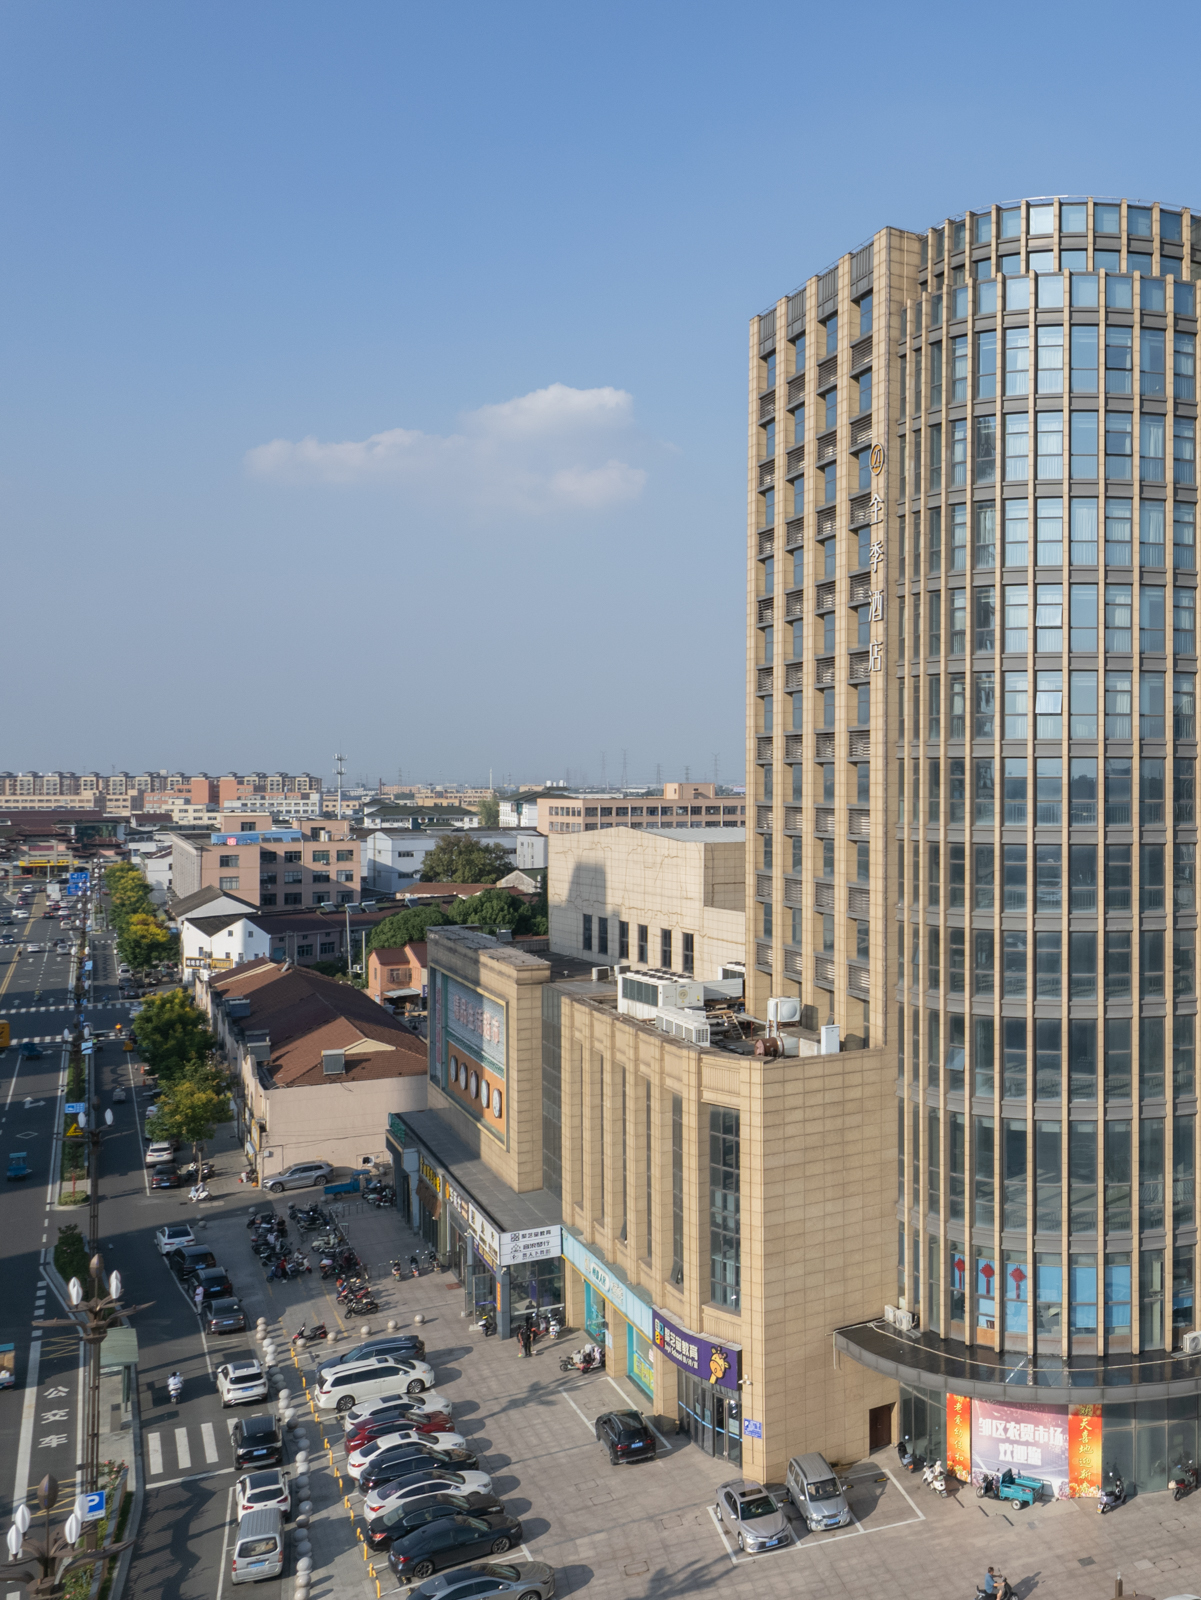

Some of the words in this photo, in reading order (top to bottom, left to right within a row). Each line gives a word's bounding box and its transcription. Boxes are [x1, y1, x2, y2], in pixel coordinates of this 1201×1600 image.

[869, 493, 884, 673] 全季酒店
[38, 1386, 70, 1448] 公交车
[978, 1417, 1064, 1447] 邹区农贸市场
[999, 1443, 1042, 1466] 欢迎您
